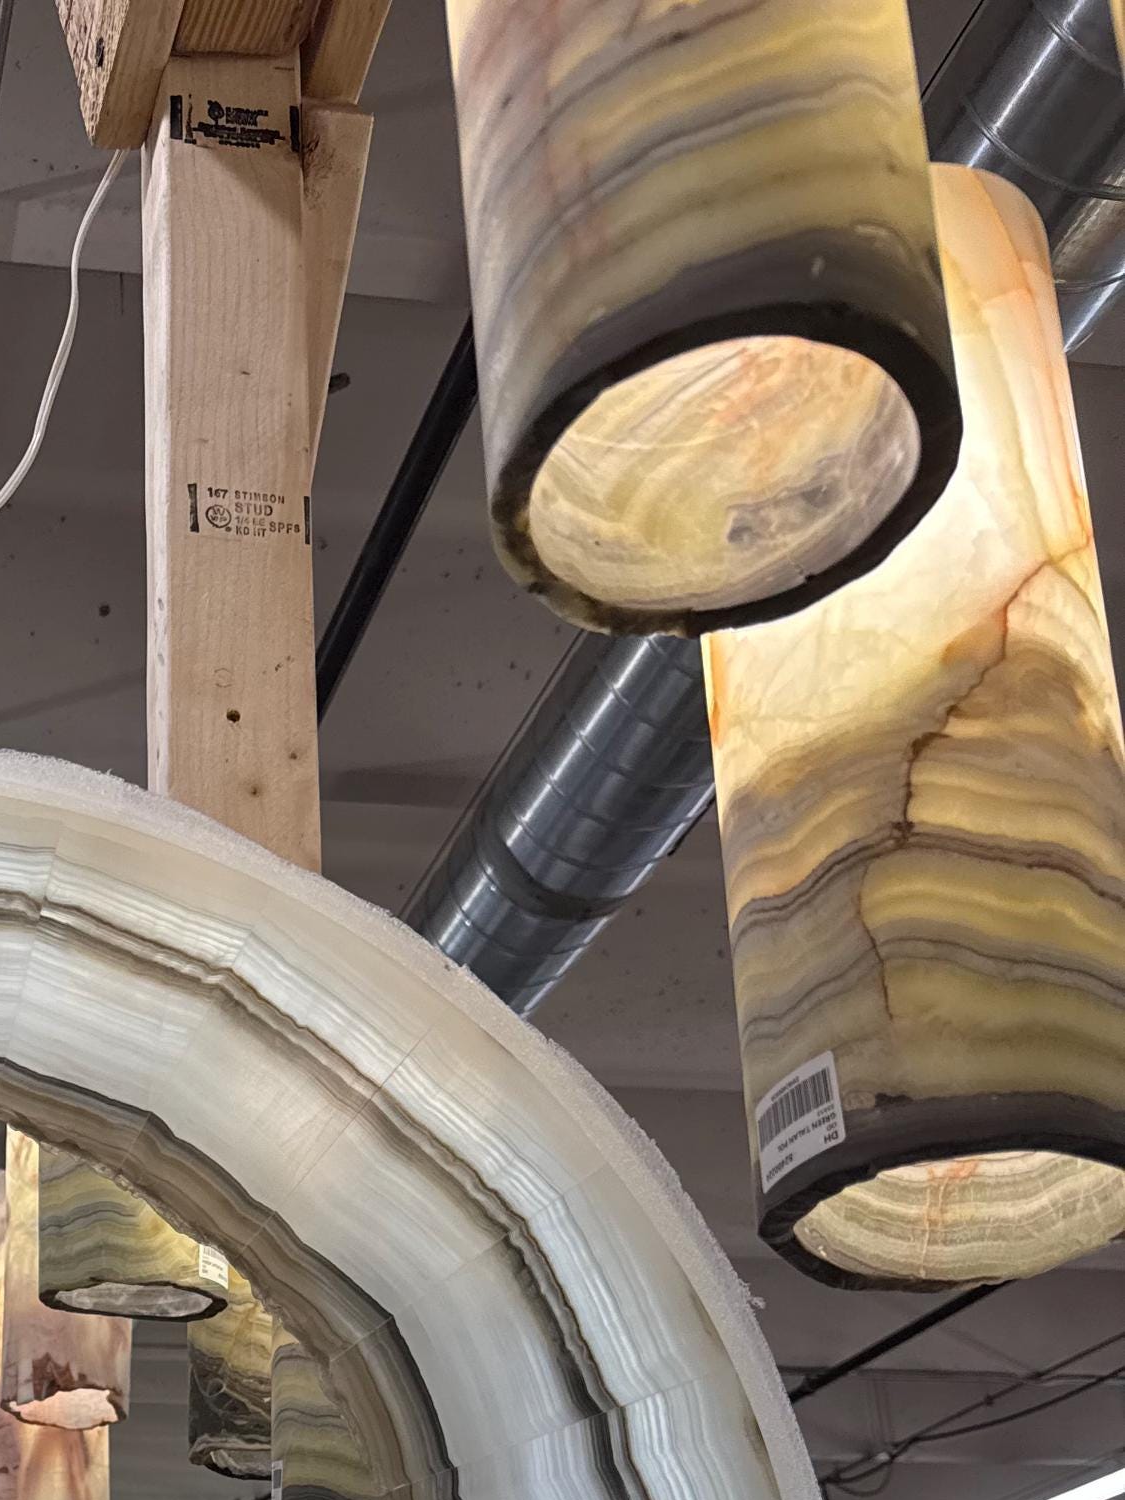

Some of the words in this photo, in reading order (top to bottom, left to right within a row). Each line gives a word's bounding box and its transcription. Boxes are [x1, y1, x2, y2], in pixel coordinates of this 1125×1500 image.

[207, 487, 228, 499] 167
[235, 502, 273, 516] STUD
[824, 1130, 839, 1144] DH
